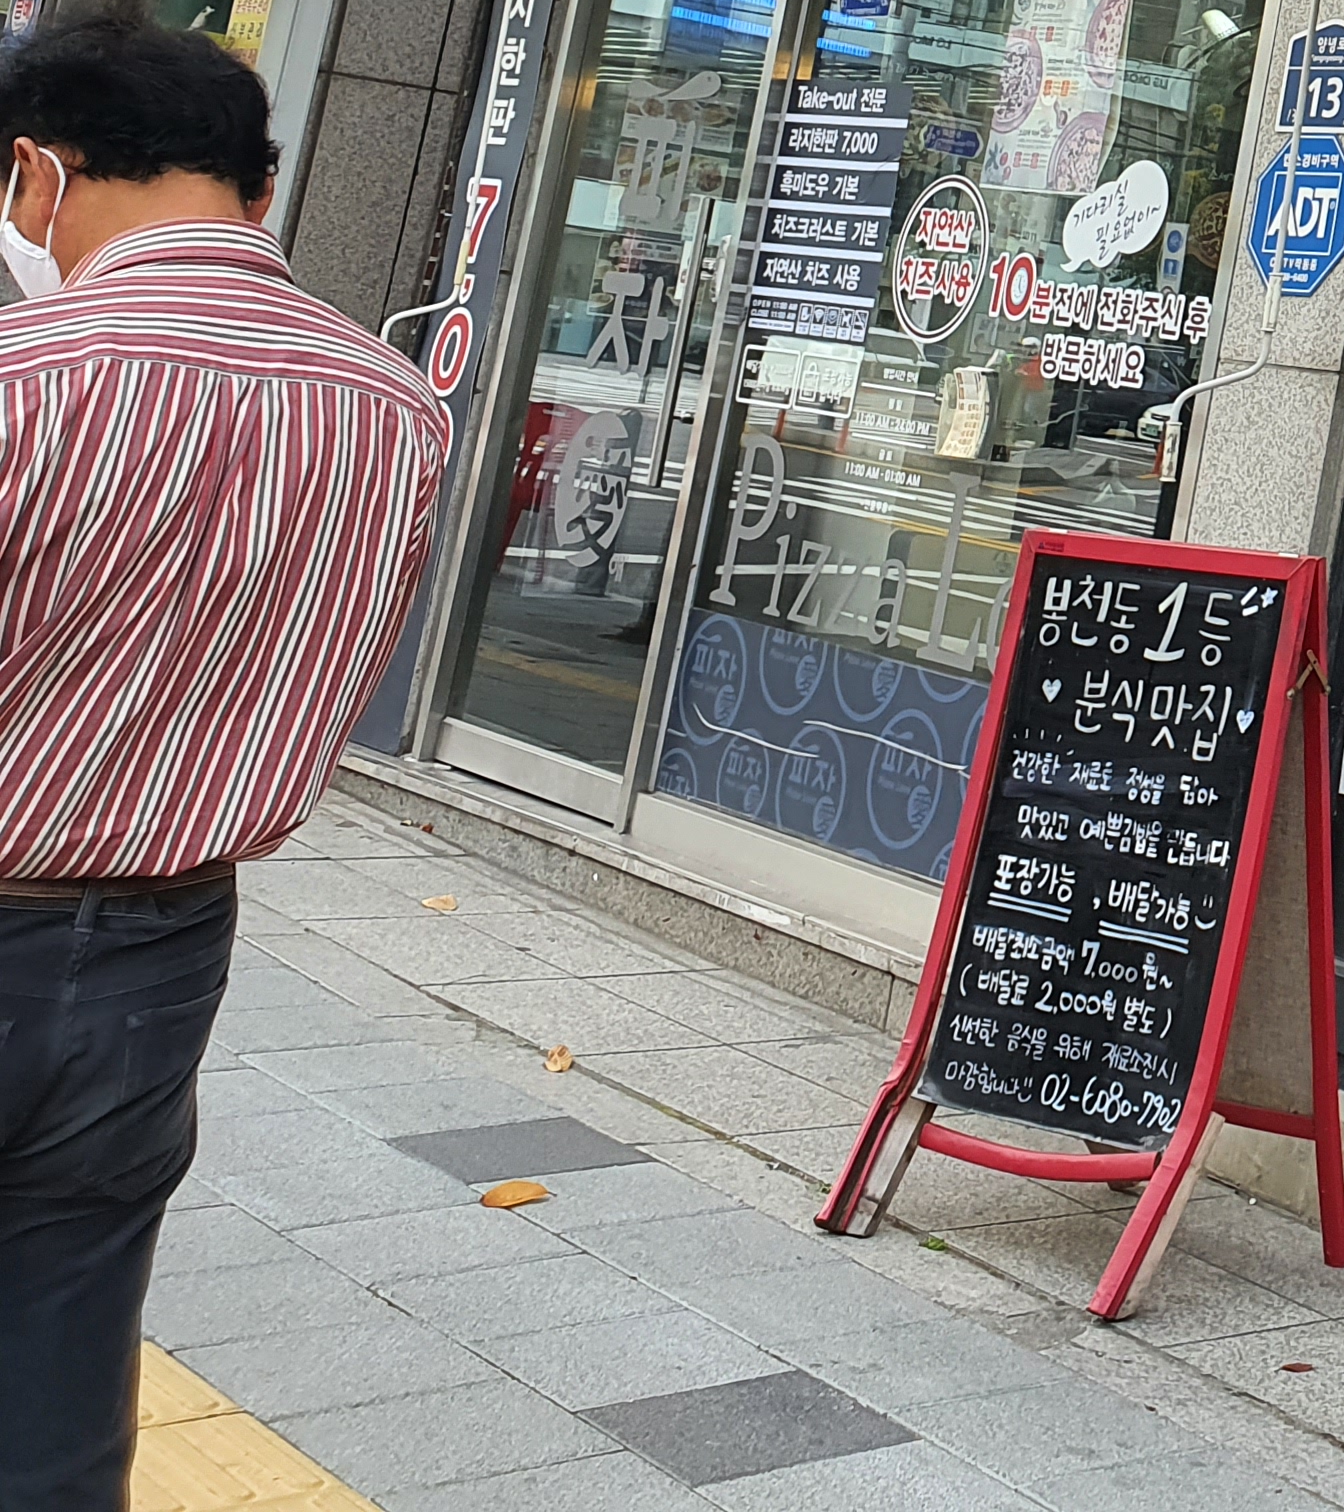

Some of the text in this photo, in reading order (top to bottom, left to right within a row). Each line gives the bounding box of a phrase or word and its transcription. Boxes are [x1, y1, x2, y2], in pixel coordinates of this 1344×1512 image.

[797, 85, 887, 114] Take-out 전문
[1308, 76, 1344, 119] 13
[788, 126, 879, 156] 라지한판 7,000
[780, 169, 860, 201] 흑미도우 기본
[771, 213, 880, 247] 치즈크러스트 기본
[915, 207, 976, 253] 자연산
[1267, 185, 1340, 239] ADT
[762, 257, 862, 292] 자연산 치즈 사용
[899, 256, 975, 308] 치즈 사용
[1097, 285, 1186, 341] 전화주신
[1183, 295, 1213, 345] 후
[1039, 333, 1146, 390] 방문하세요
[1038, 574, 1141, 654] 봉천동
[691, 643, 738, 681] 피자
[1012, 749, 1061, 785] 건강한
[1126, 767, 1166, 805] 정성을
[1179, 774, 1219, 806] 담아
[1017, 804, 1070, 841] 맛있고
[993, 854, 1192, 931] 포장가능 배달가능
[949, 1013, 1000, 1048] 신선한
[1006, 1022, 1048, 1061] 음식을
[1053, 1033, 1093, 1062] 위해
[1040, 1073, 1183, 1134] 02-6080-7902
